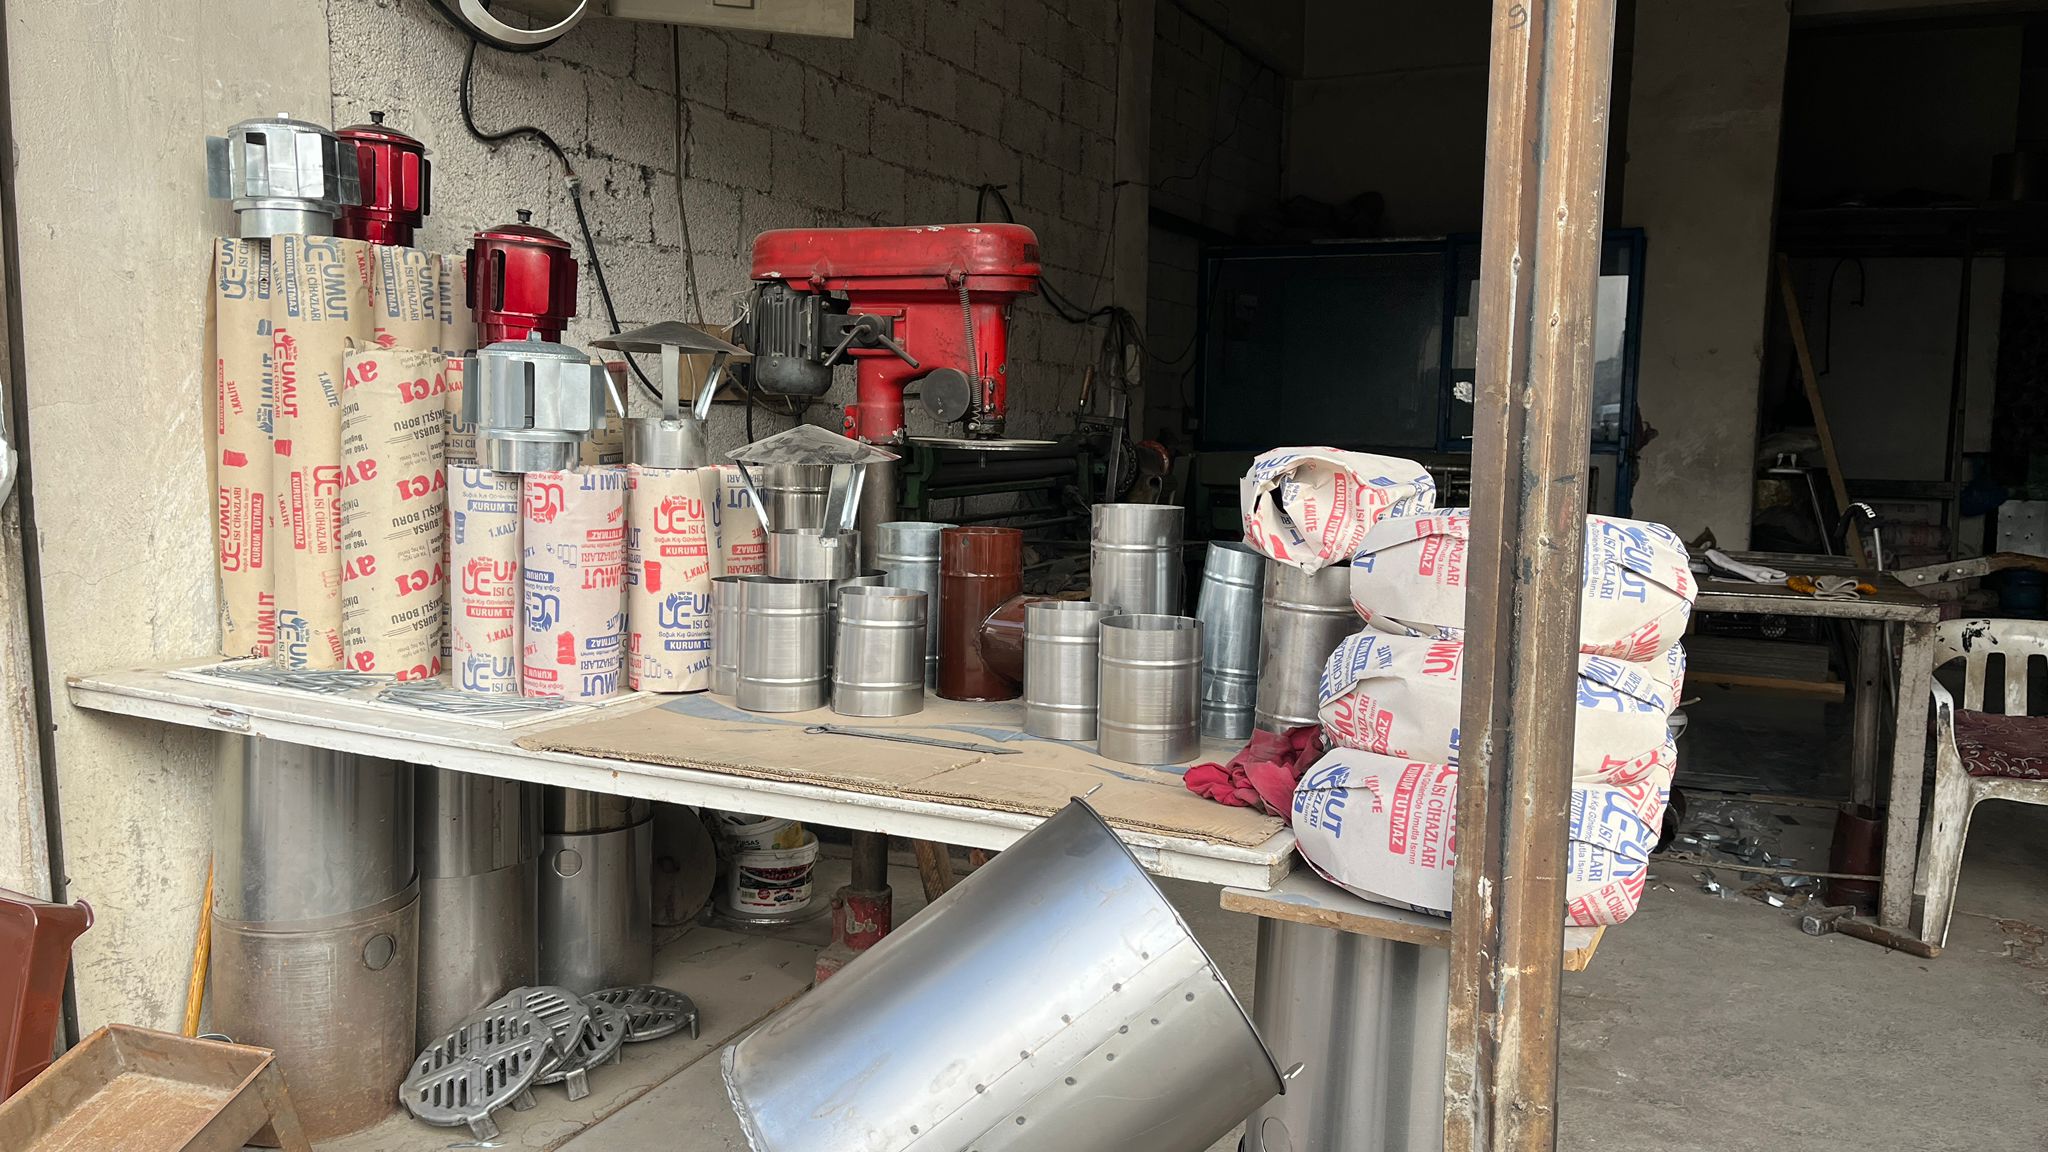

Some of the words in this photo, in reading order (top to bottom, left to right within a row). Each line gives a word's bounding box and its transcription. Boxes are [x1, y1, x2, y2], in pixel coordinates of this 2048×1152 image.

[285, 241, 295, 275] KURUM
[306, 264, 316, 275] ISI
[382, 247, 392, 278] KURUM
[405, 266, 414, 278] ISI
[287, 278, 298, 313] TUTMAZ
[307, 277, 322, 321] CİHAZLARI
[323, 264, 349, 321] UMUT
[385, 280, 399, 313] TUTMAZ
[406, 280, 420, 321] CİHAZLARI
[420, 267, 435, 320] UMUT
[227, 380, 243, 415] 1.KALİTE
[282, 361, 298, 418] UMUT
[318, 372, 340, 408] 1.KALİTE
[394, 416, 420, 431] BORU
[413, 424, 440, 439] BURSA
[292, 477, 303, 509] KURUM
[496, 481, 507, 491] ISI
[1333, 479, 1345, 517] KURUM
[220, 485, 230, 539] UMUT
[233, 487, 242, 529] CİHAZLARI
[252, 497, 263, 528] TUTMAZ
[277, 494, 290, 528] 1.KALİTE
[314, 498, 325, 509] ISI
[472, 501, 505, 512] KURUM
[1304, 497, 1320, 533] 1.KALİTE
[1356, 508, 1364, 522] ISI
[294, 511, 305, 545] TUTMAZ
[315, 511, 328, 554] CİHAZLARI
[392, 512, 420, 528] BORU
[412, 519, 440, 535] BURSA
[591, 530, 619, 539] TUTMAZ
[688, 525, 699, 535] ISI
[233, 530, 242, 541] ISI
[251, 532, 262, 565] KURUM
[665, 546, 698, 555] KURUM
[581, 549, 616, 562] CİHAZLARI
[493, 587, 505, 597] ISI
[391, 608, 420, 625] BORU
[412, 613, 439, 631] BURSA
[471, 608, 502, 617] KURUM
[692, 620, 703, 630] ISI
[325, 628, 345, 662] 1.KALİTE
[669, 640, 701, 650] KURUM
[492, 683, 503, 692] ISI
[1431, 783, 1448, 797] ISI
[1391, 796, 1410, 848] TUTMAZ
[1411, 811, 1423, 841] Umutla
[1421, 801, 1446, 869] CİHAZLARI
[1409, 842, 1418, 865] Isının
